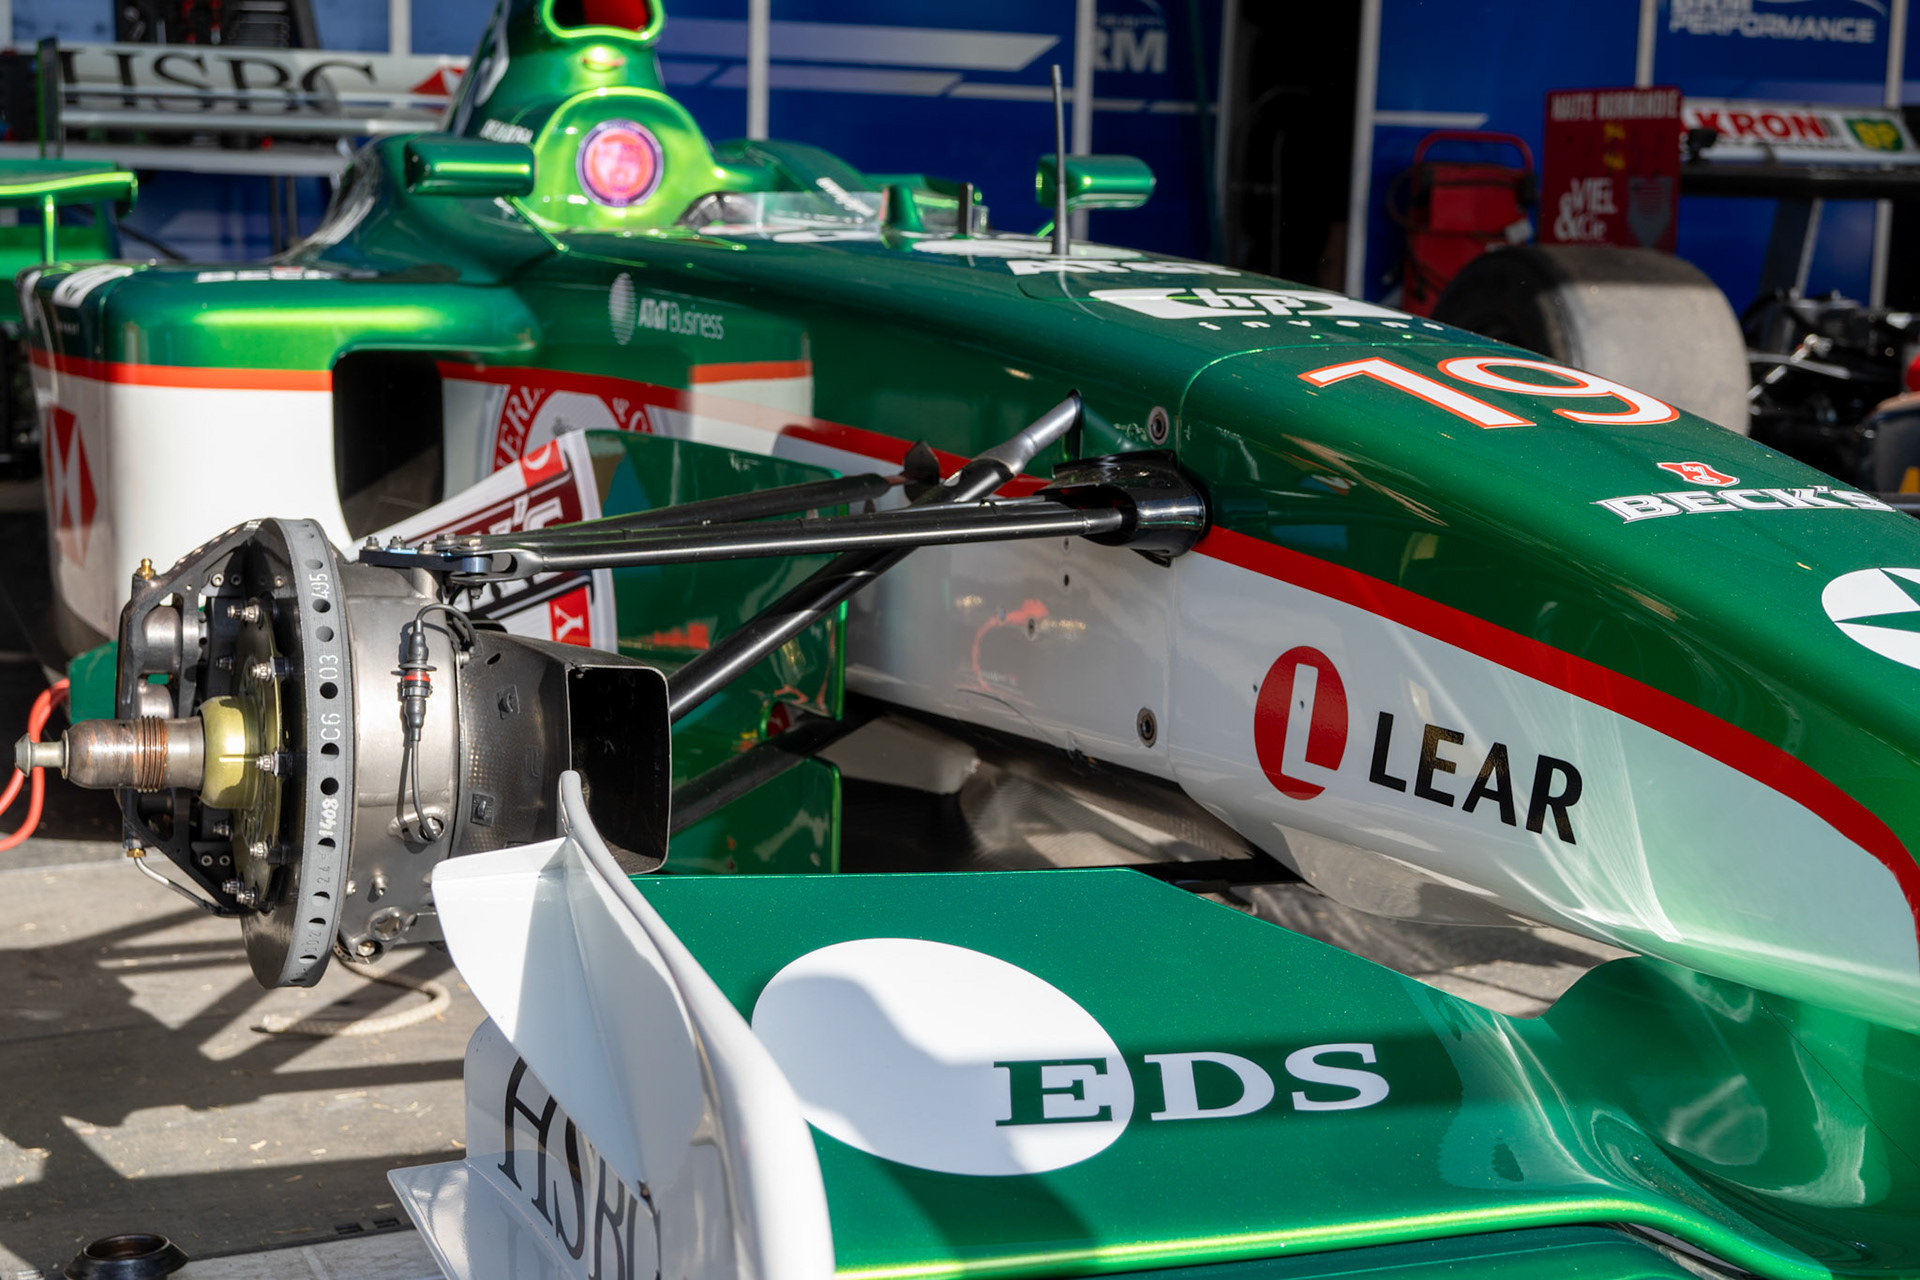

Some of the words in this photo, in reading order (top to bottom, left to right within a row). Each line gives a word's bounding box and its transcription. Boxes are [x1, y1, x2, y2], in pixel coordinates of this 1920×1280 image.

[1668, 12, 1876, 43] PERFORMANCE
[668, 301, 725, 341] Business
[1190, 287, 1307, 316] hp
[1298, 355, 1680, 430] 19
[1589, 484, 1897, 524] BECK'S
[319, 712, 341, 741] C6
[1368, 711, 1584, 846] LEAR
[993, 1042, 1391, 1128] EDS
